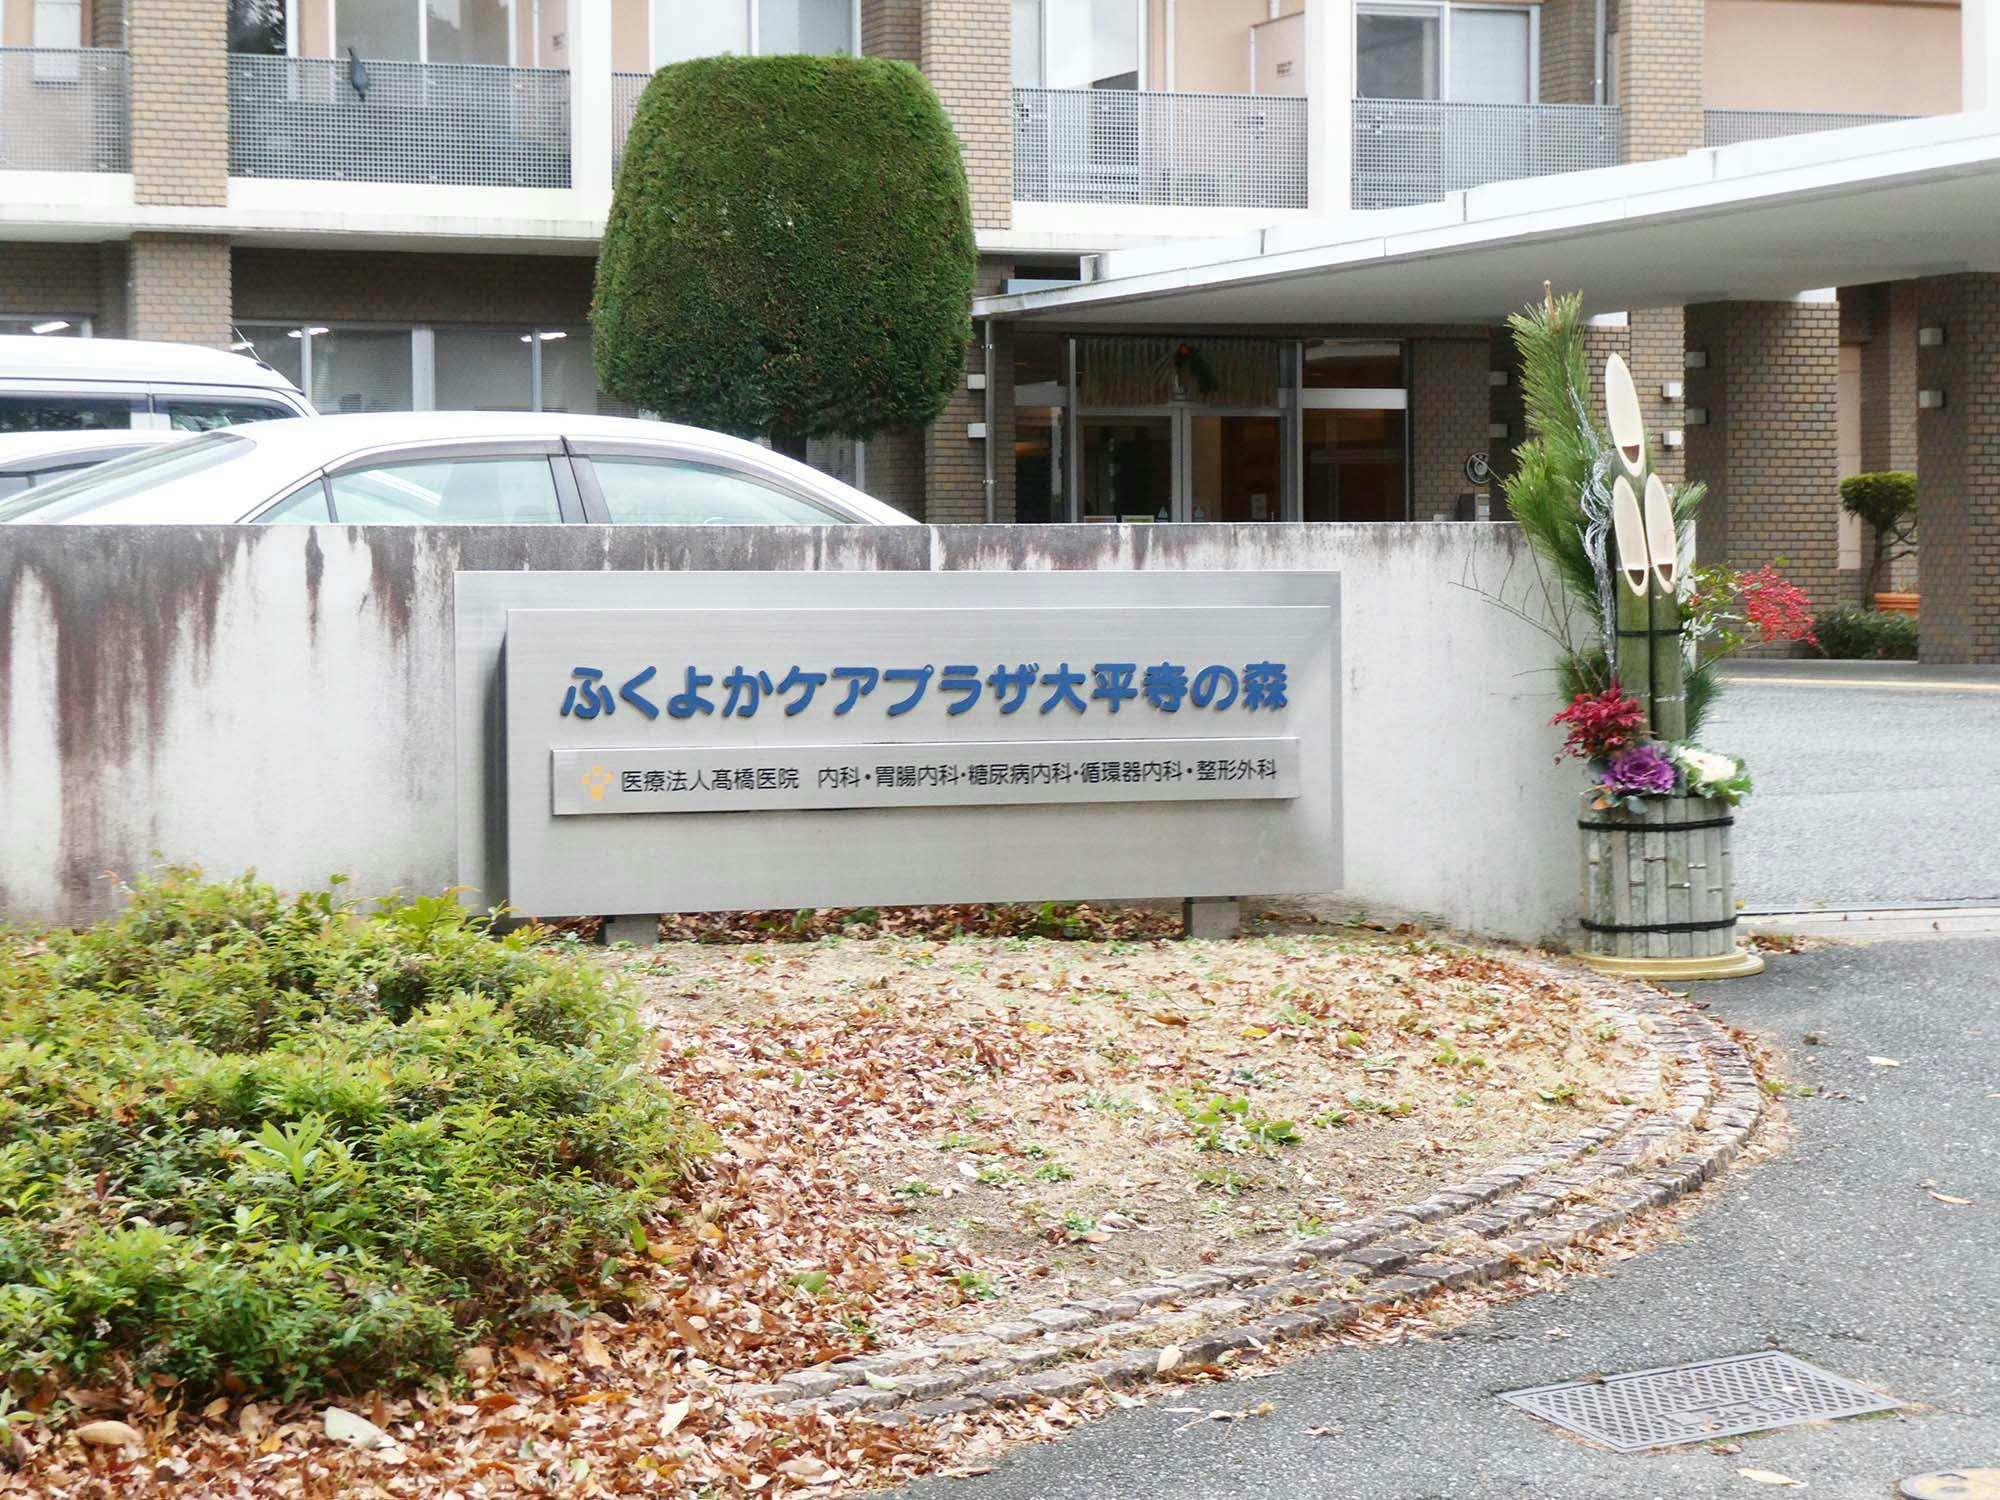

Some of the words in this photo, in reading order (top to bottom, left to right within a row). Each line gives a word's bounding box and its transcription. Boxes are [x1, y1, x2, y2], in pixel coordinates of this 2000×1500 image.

[561, 661, 1288, 719] ふくよかケアプラザ大平寺の森
